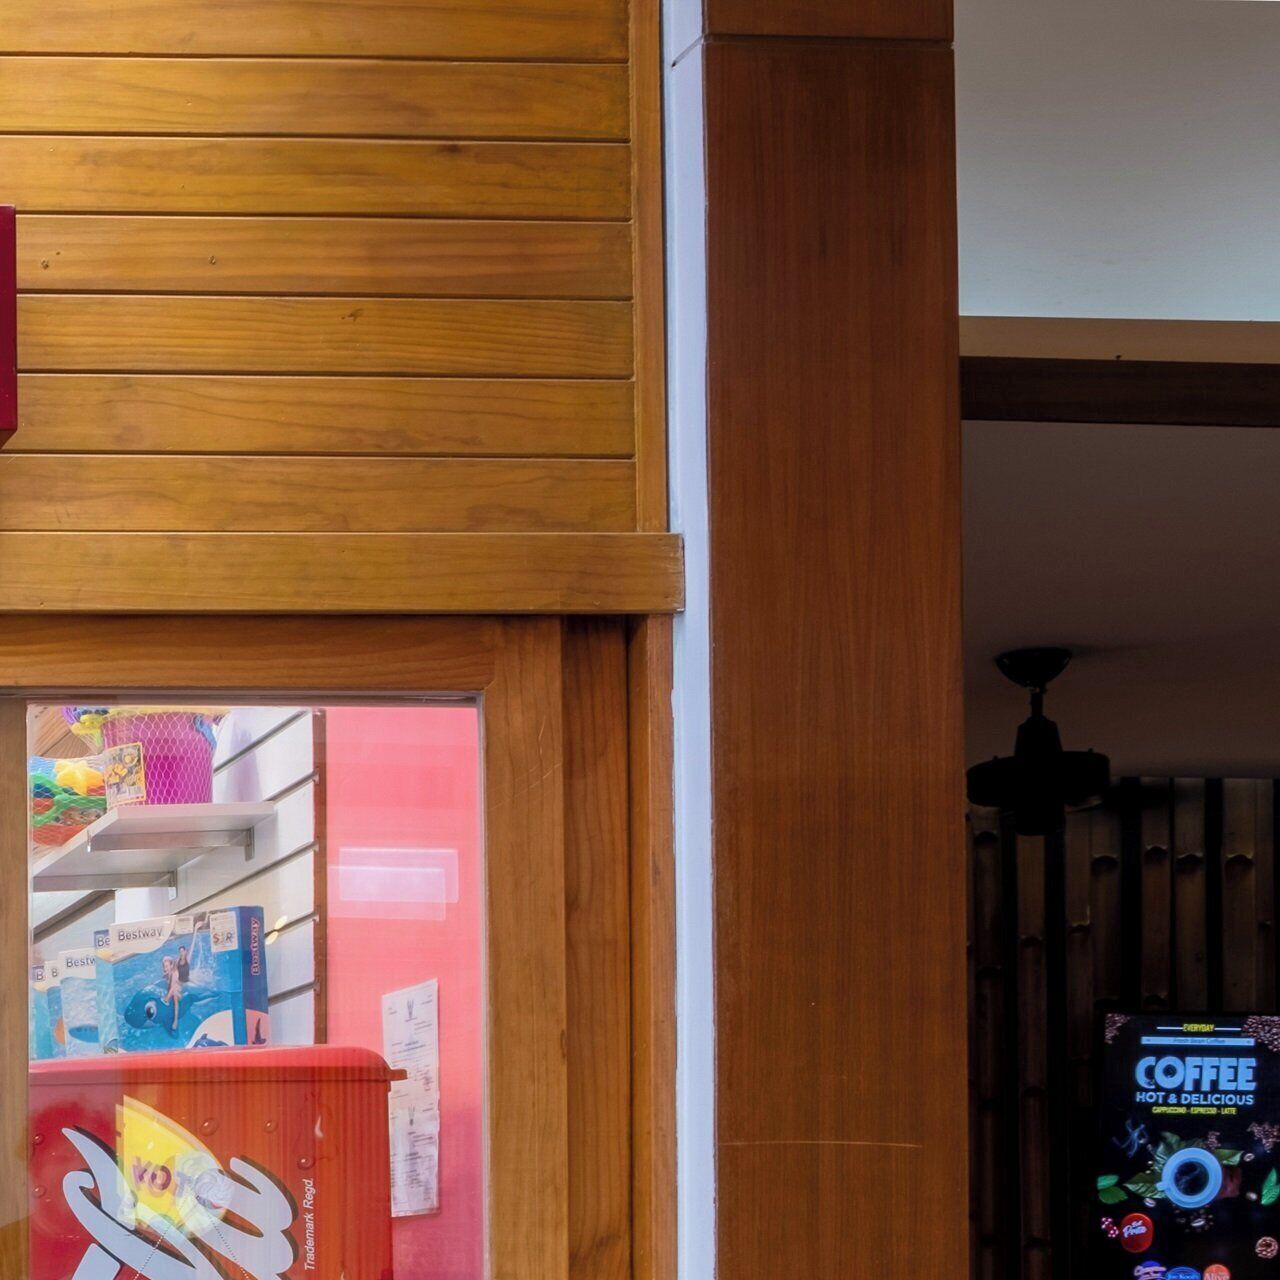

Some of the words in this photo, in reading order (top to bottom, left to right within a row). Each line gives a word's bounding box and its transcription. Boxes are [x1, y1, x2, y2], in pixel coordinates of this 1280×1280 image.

[118, 928, 164, 941] Bestway
[1135, 1056, 1257, 1091] COFFEE
[1136, 1092, 1165, 1103] HOT
[1168, 1094, 1178, 1104] &
[1181, 1094, 1254, 1105] DELICIOUS
[303, 1212, 316, 1271] Trademark
